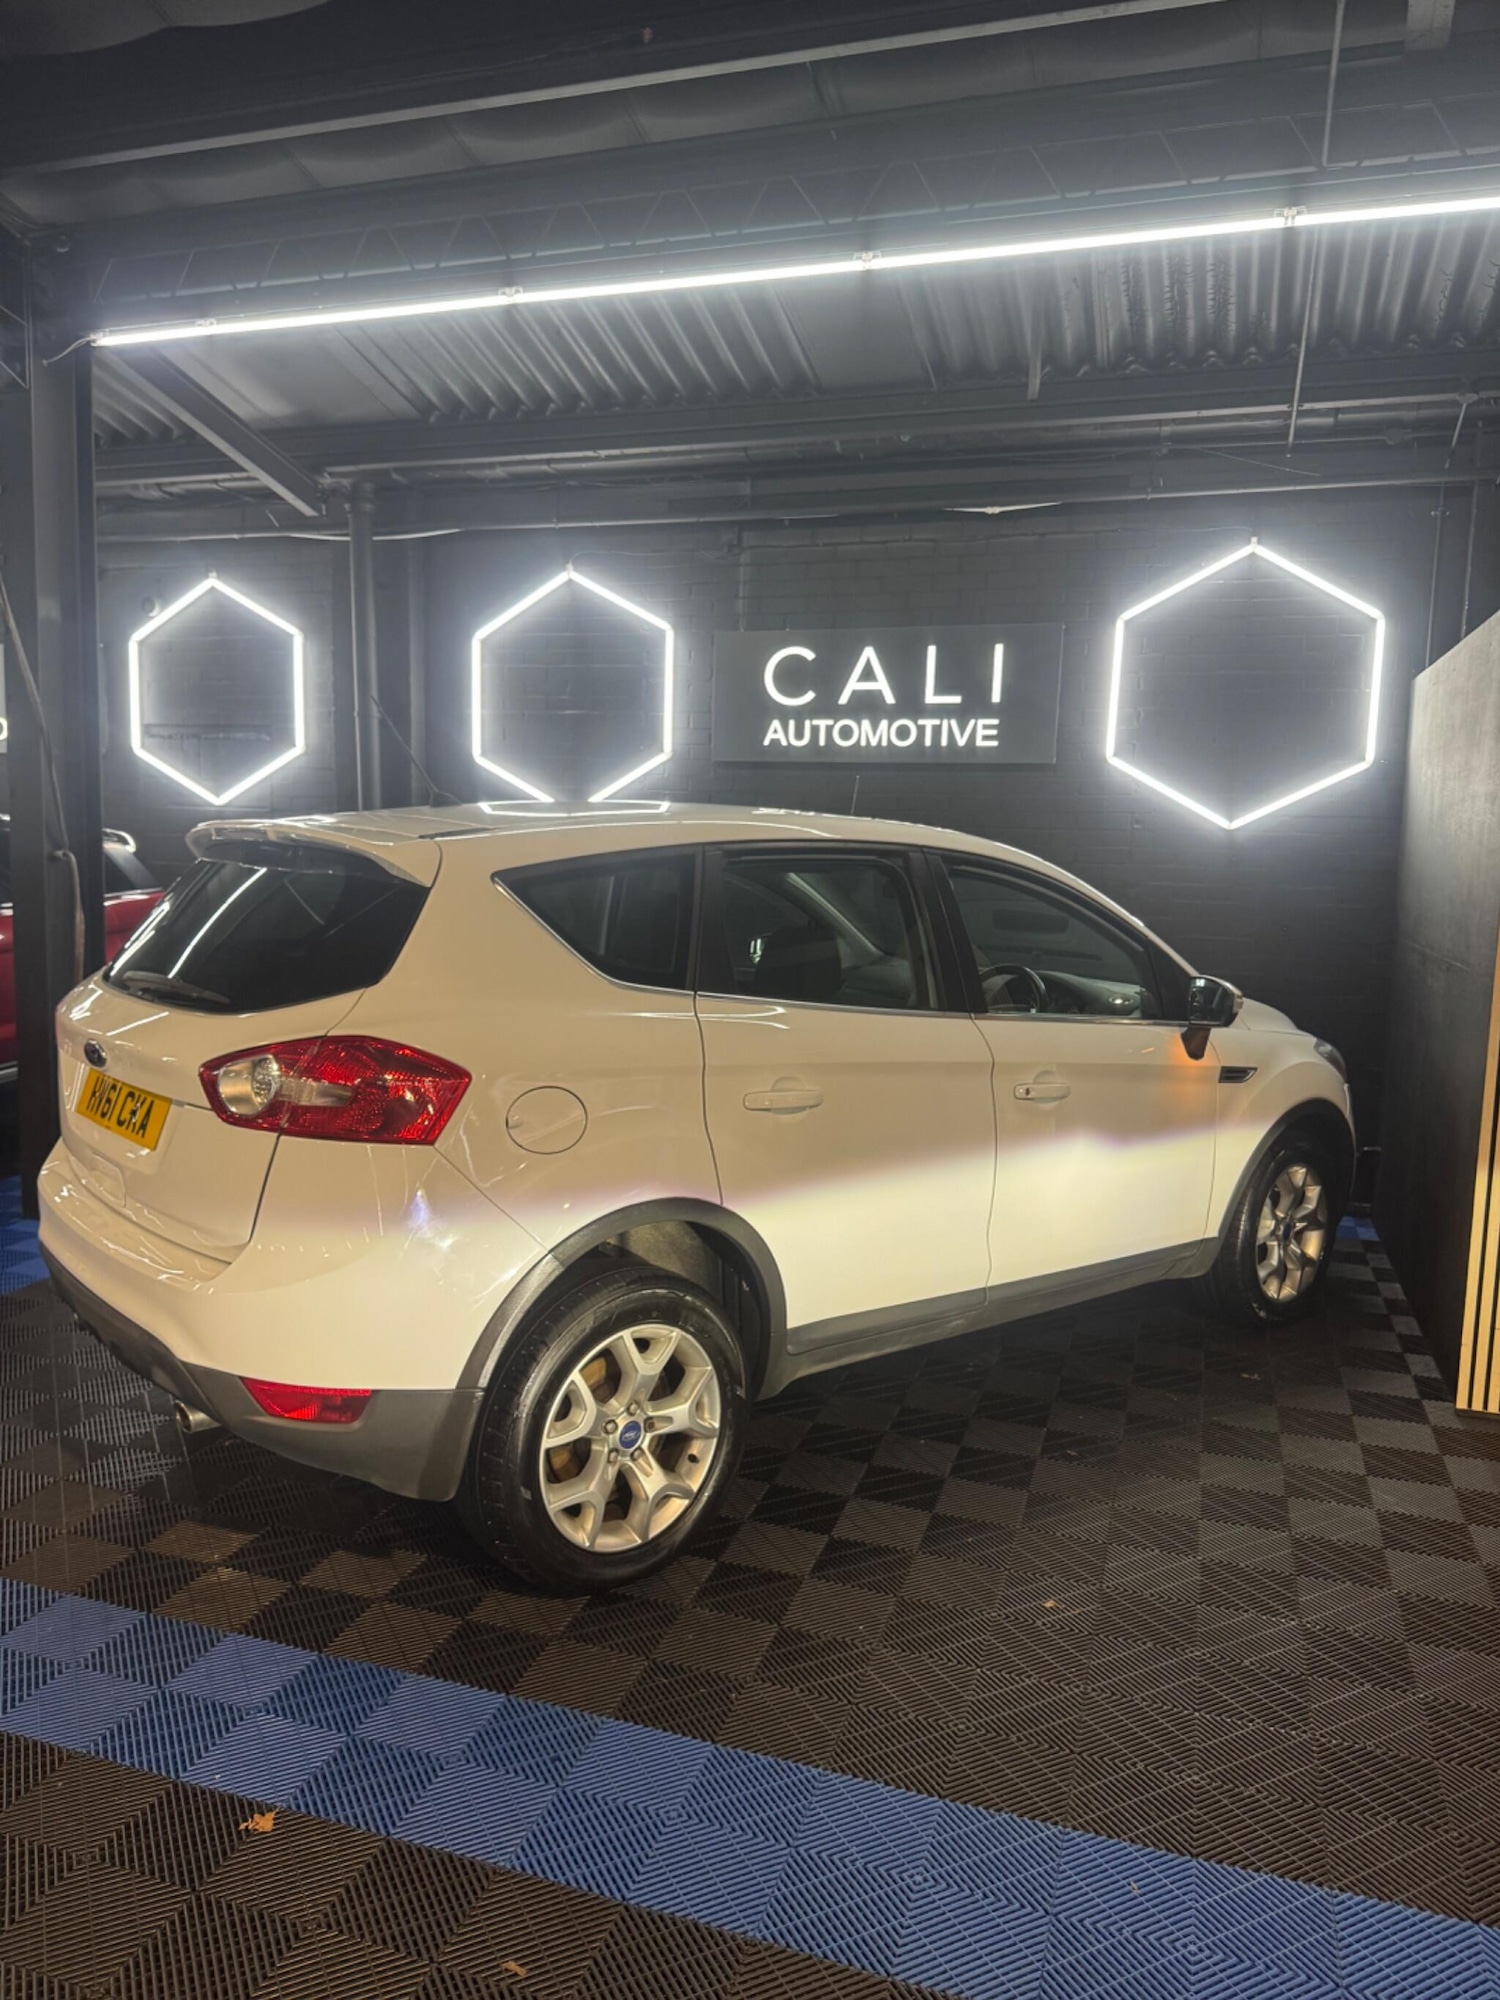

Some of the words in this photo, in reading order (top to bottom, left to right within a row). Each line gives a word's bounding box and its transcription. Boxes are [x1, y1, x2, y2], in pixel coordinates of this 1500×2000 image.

[763, 643, 1004, 706] CALI
[763, 718, 1000, 747] AUTOMOTIVE
[116, 1090, 155, 1139] CKA
